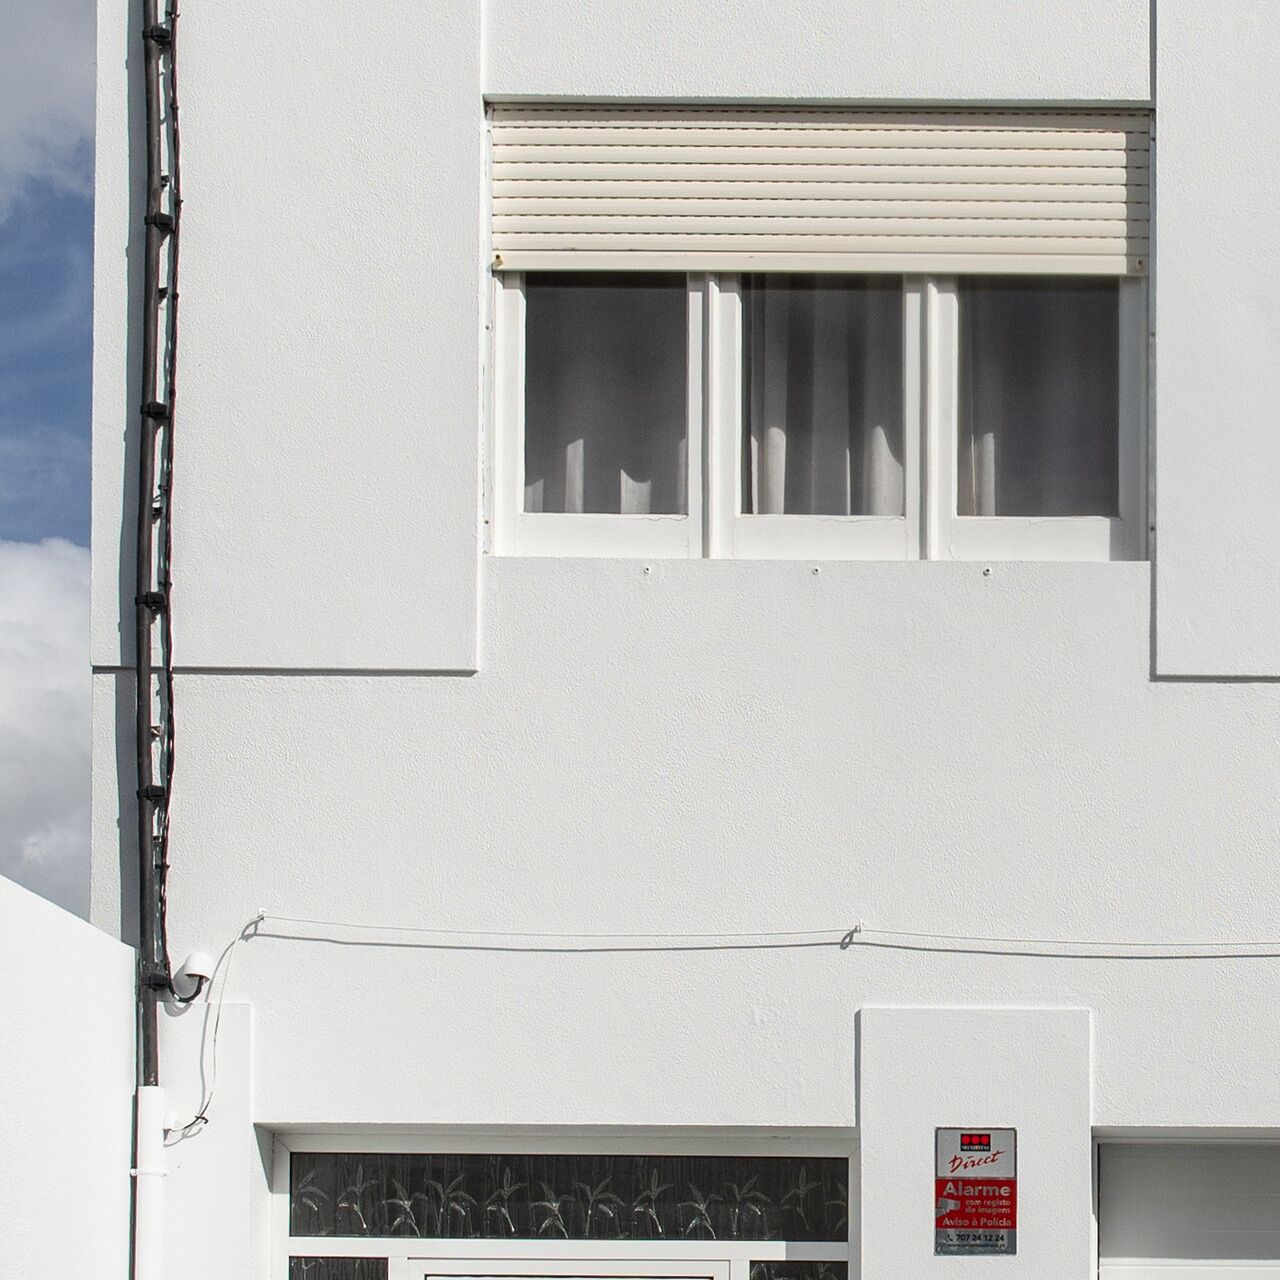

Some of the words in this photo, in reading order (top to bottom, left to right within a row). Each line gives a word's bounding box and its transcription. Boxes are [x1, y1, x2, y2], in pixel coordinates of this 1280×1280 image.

[948, 1150, 1007, 1173] Direct
[943, 1181, 1011, 1196] Alarme
[983, 1199, 1011, 1207] registo
[942, 1217, 969, 1226] Aviso
